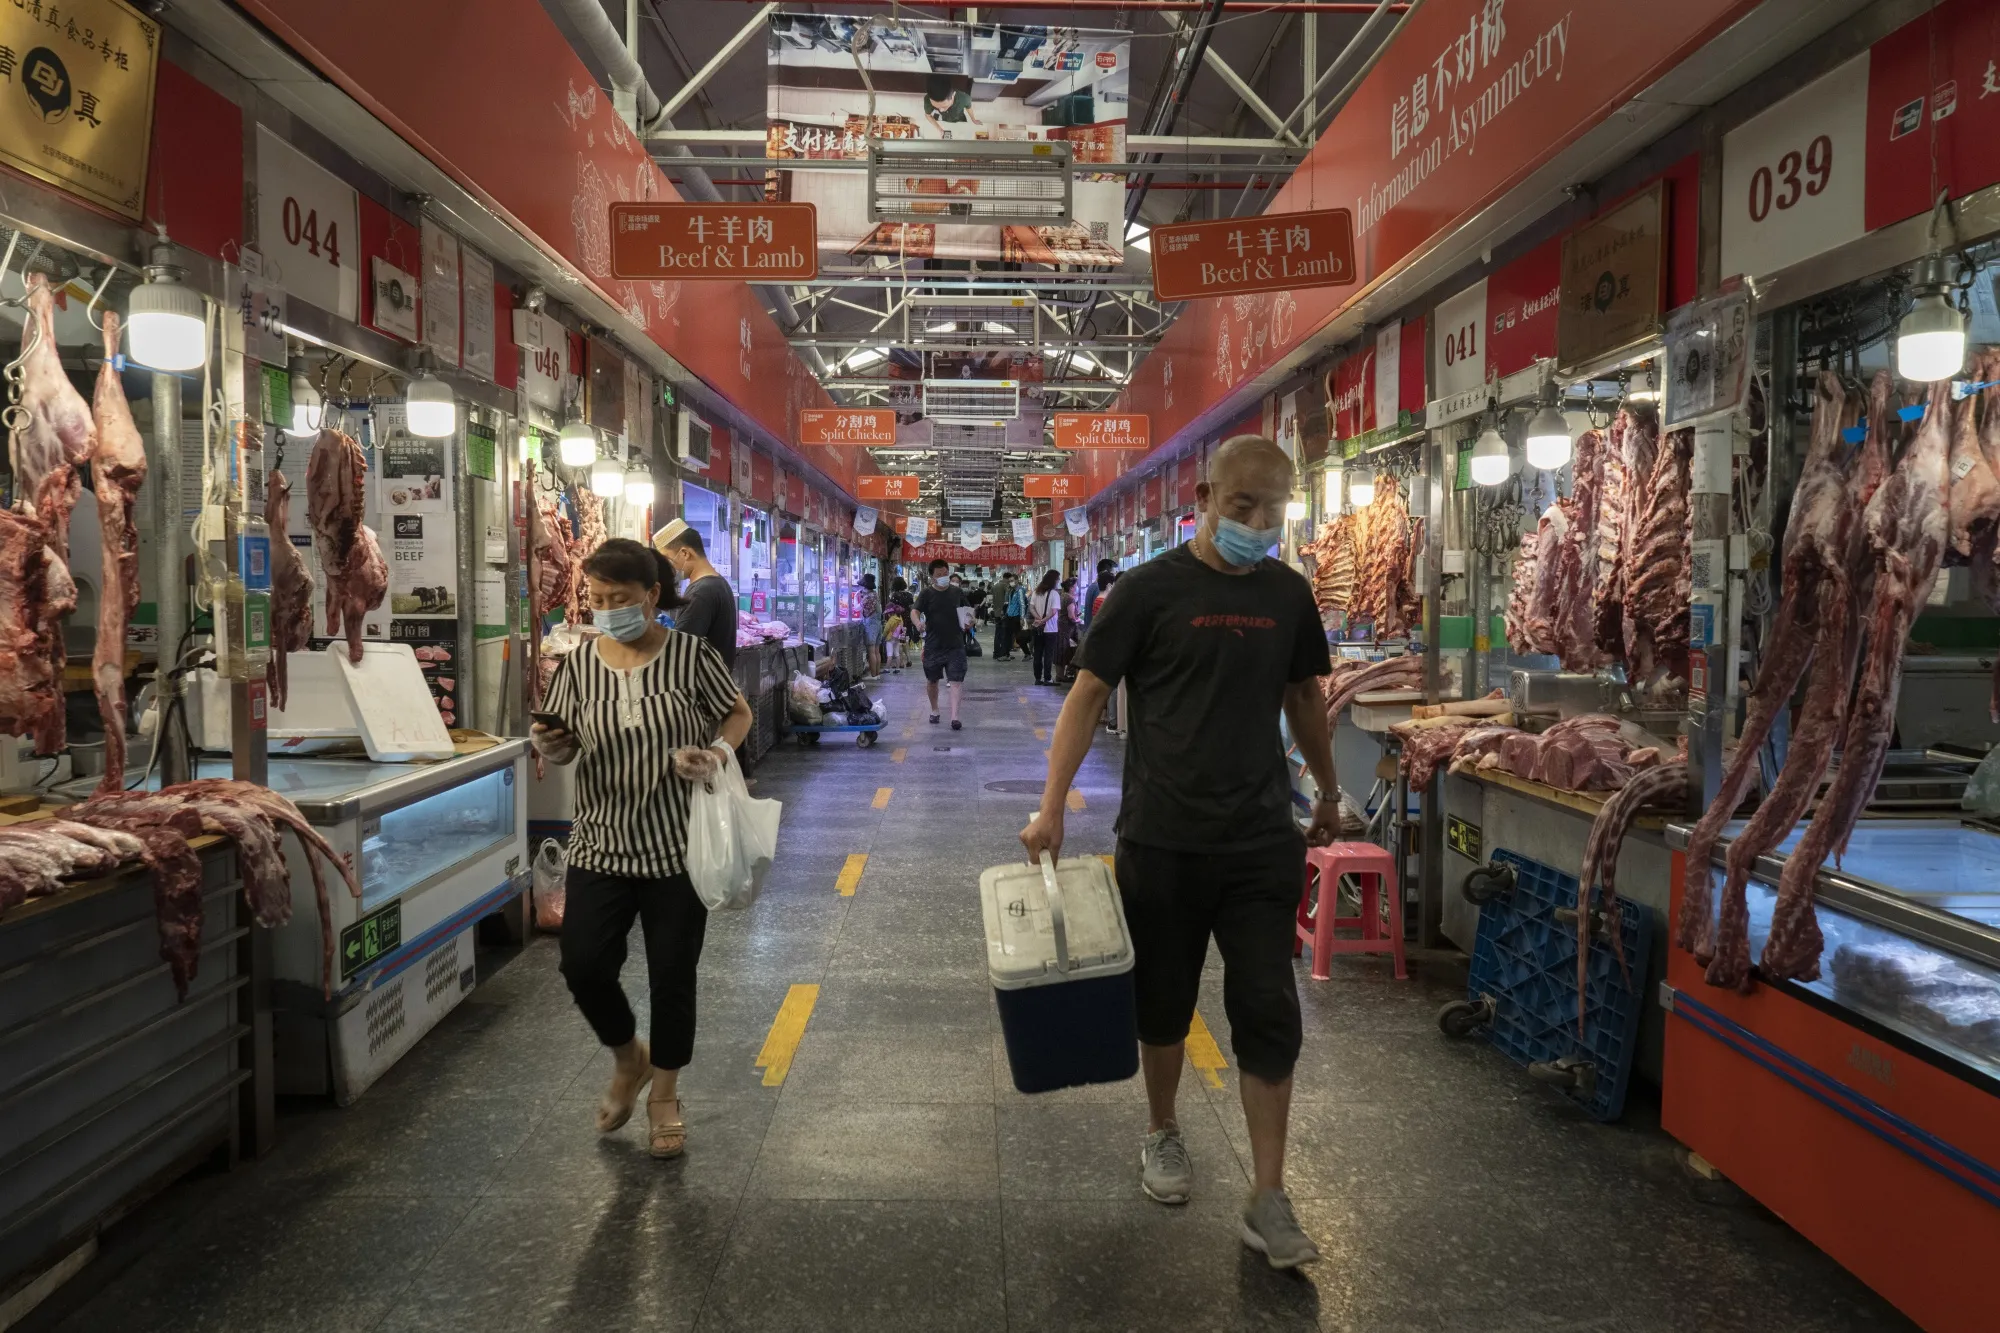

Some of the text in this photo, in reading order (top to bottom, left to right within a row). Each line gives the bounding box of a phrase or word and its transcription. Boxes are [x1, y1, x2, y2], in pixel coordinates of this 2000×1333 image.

[1389, 0, 1507, 160] 信息不对称
[1355, 11, 1574, 239] Information Asymmetry
[1748, 134, 1833, 223] 039
[282, 196, 341, 268] 044
[687, 215, 774, 244] 牛羊肉
[1226, 224, 1312, 259] 牛羊肉
[658, 245, 805, 269] Beef & Lamb
[1200, 251, 1344, 287] Beef & Lamb
[1445, 320, 1478, 367] 041
[535, 347, 560, 382] 046
[388, 416, 408, 425] BEE
[836, 415, 877, 429] 分割鸡
[1090, 419, 1131, 433] 分割鸡
[820, 427, 892, 442] Split Chicken
[1075, 432, 1146, 447] Split Chicken
[885, 479, 903, 489] 大肉
[1051, 477, 1069, 487] 大肉
[1051, 487, 1068, 495] Pork
[885, 488, 902, 496] Pork
[395, 551, 424, 561] BEEF
